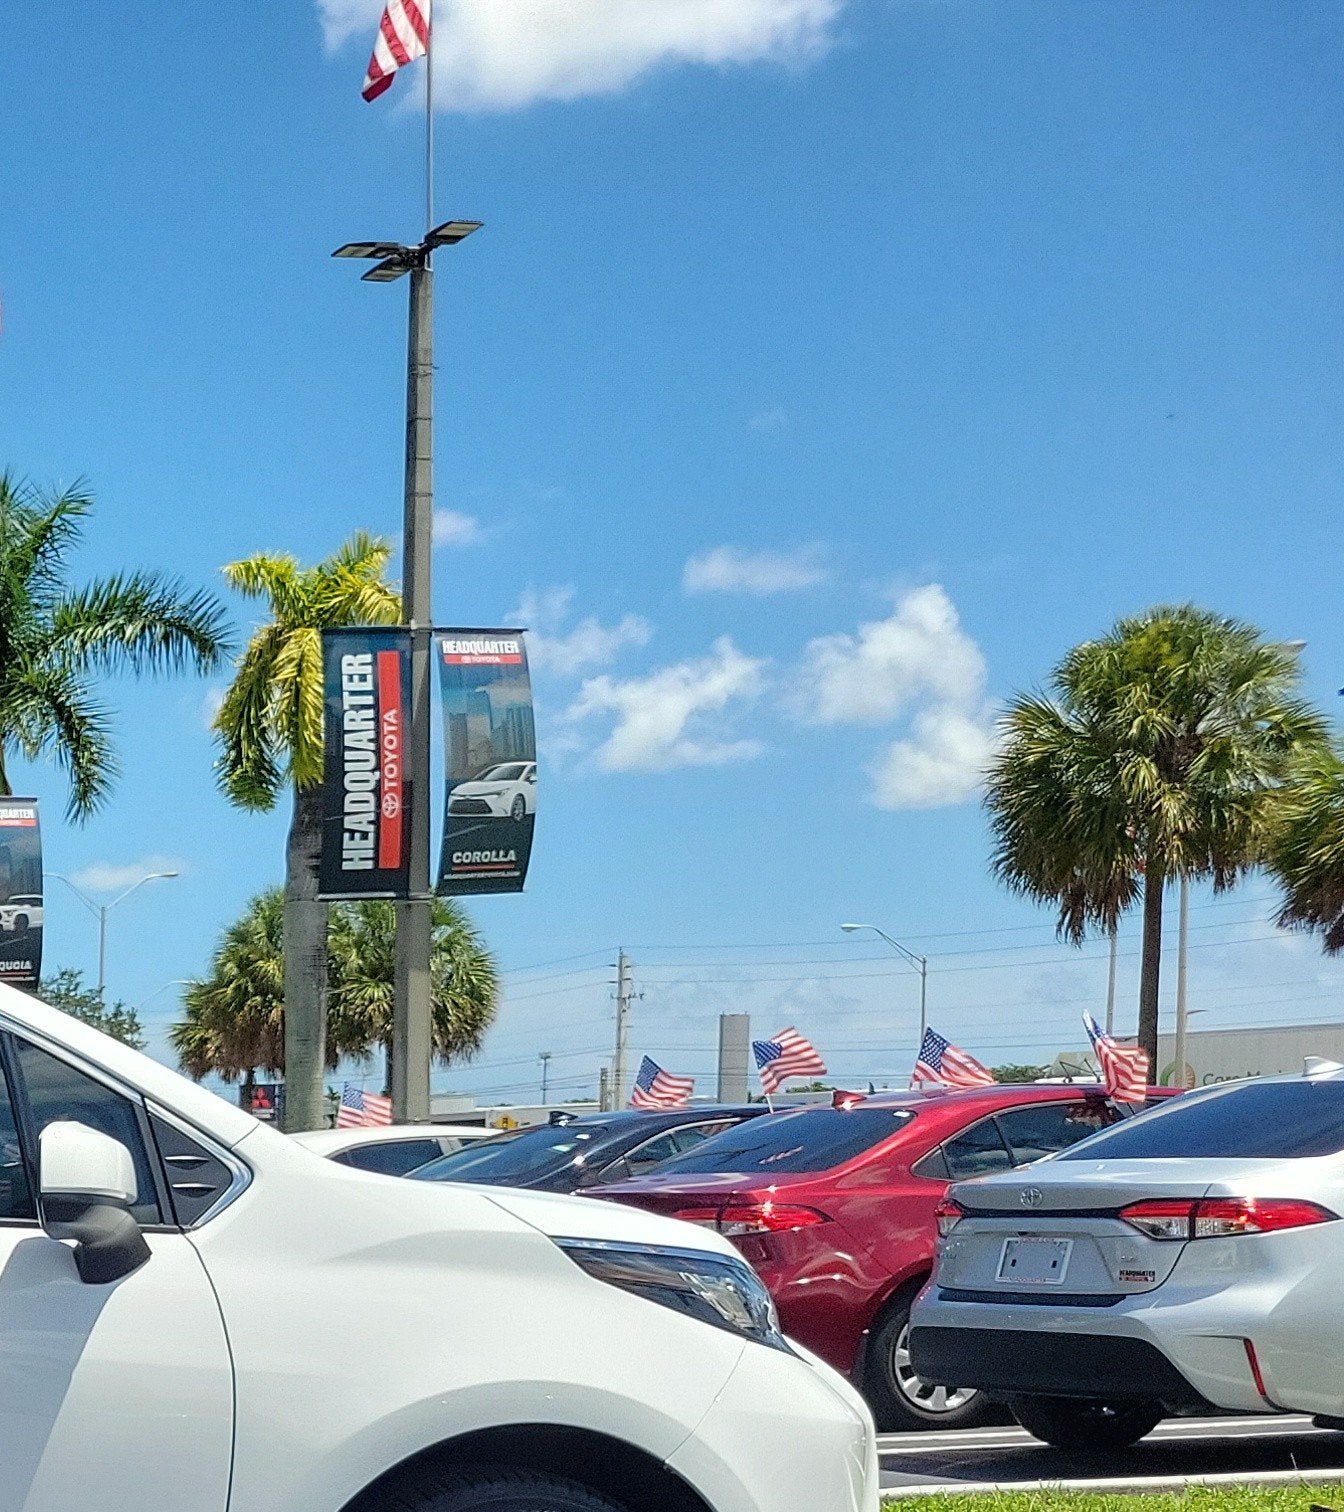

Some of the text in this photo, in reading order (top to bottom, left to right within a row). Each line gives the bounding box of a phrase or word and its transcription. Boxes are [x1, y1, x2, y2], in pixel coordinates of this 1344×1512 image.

[442, 640, 519, 655] HEADQUARTER
[340, 653, 380, 870] HEADQUARTER
[382, 708, 399, 790] TOYOTA
[452, 850, 516, 863] COROLLA
